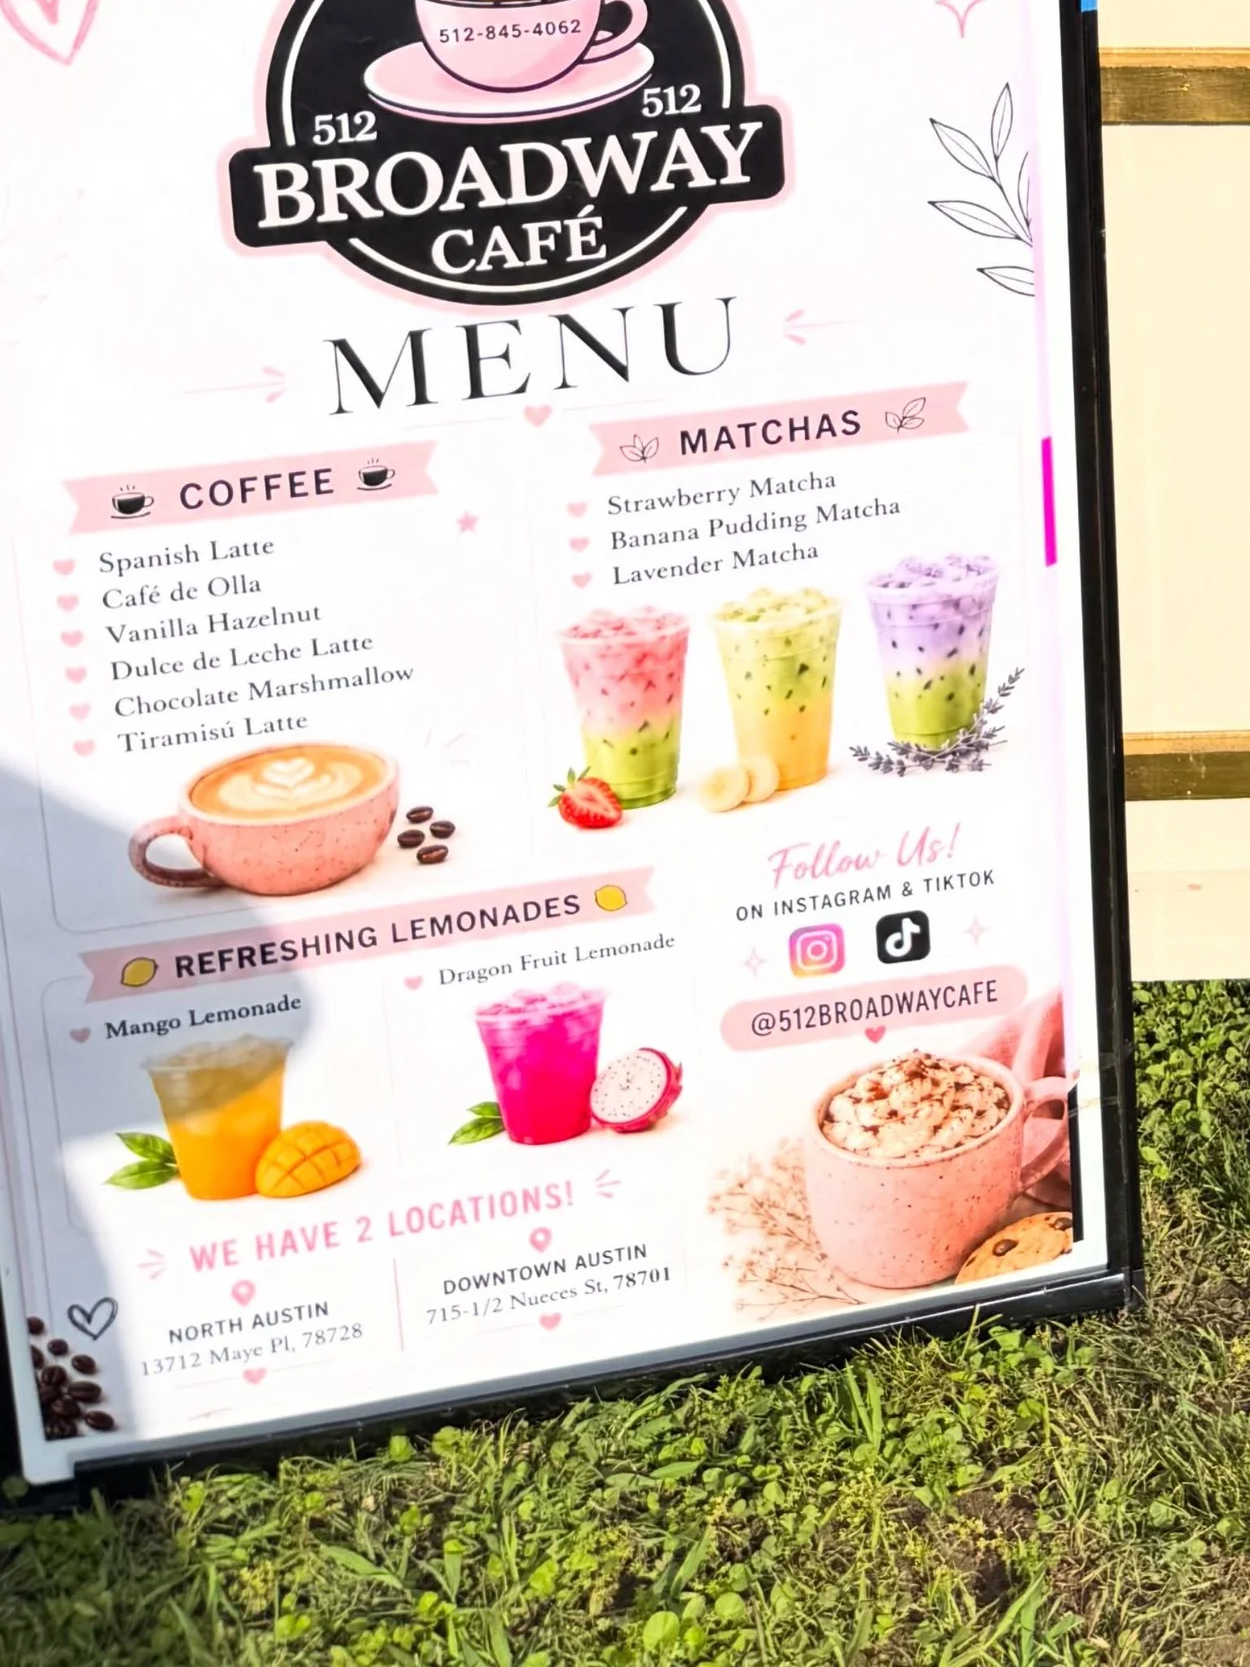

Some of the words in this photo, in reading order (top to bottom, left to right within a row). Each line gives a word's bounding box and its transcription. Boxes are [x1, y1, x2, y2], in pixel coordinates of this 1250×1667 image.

[439, 19, 581, 43] 512-845-4062
[641, 83, 702, 118] 512
[312, 110, 378, 146] 512
[254, 121, 763, 228] BROADWAY
[431, 204, 607, 275] CAFÉ
[323, 297, 735, 415] MENU
[680, 409, 861, 456] MATCHAS
[179, 467, 334, 510] COFFEE
[607, 487, 740, 515] Strawberry
[750, 471, 836, 498] Matcha
[611, 527, 700, 550] Banana
[709, 511, 808, 538] Pudding
[816, 497, 901, 524] Matcha
[99, 543, 200, 578] Spanish
[210, 539, 274, 561] Latte
[613, 555, 724, 585] Lavender
[732, 542, 819, 570] Matcha
[102, 584, 161, 609] Café
[169, 581, 198, 602] de
[207, 574, 262, 597] Olla
[106, 617, 198, 644] Vanilla
[208, 606, 320, 634] Hazelnut
[111, 656, 184, 681] Dulce
[192, 651, 220, 671] de
[230, 642, 301, 667] Leche
[311, 636, 374, 657] Latte
[114, 687, 239, 717] Chocolate
[248, 665, 414, 701] Marshmallow
[117, 720, 235, 753] Tiramisú
[244, 716, 308, 736] Latte
[768, 840, 884, 885] Follow
[897, 822, 961, 867] Us!
[736, 903, 763, 922] ON
[774, 884, 891, 916] INSTAGRAM
[901, 881, 913, 897] &
[923, 869, 994, 893] TIKTOK
[174, 926, 377, 979] REFRESHING
[391, 894, 581, 944] LEMONADES
[439, 964, 514, 986] Dragon
[520, 950, 567, 971] Fruit
[575, 933, 675, 962] Lemonade
[105, 1018, 181, 1039] Mango
[189, 994, 301, 1027] Lemonade
[751, 980, 998, 1037] @512BROADWAYCAFE
[190, 1240, 239, 1272] WE
[255, 1221, 340, 1260] HAVE
[357, 1216, 372, 1243] 2
[388, 1180, 574, 1237] LOCATIONS!
[443, 1259, 567, 1295] DOWNTOWN
[575, 1244, 648, 1271] AUSTIN
[426, 1297, 503, 1325] 715-1/2
[510, 1289, 578, 1310] Nueces
[613, 1266, 672, 1290] 78701
[169, 1317, 242, 1343] NORTH
[252, 1302, 328, 1329] AUSTIN
[143, 1352, 201, 1376] 13712
[303, 1323, 363, 1348] 78728
